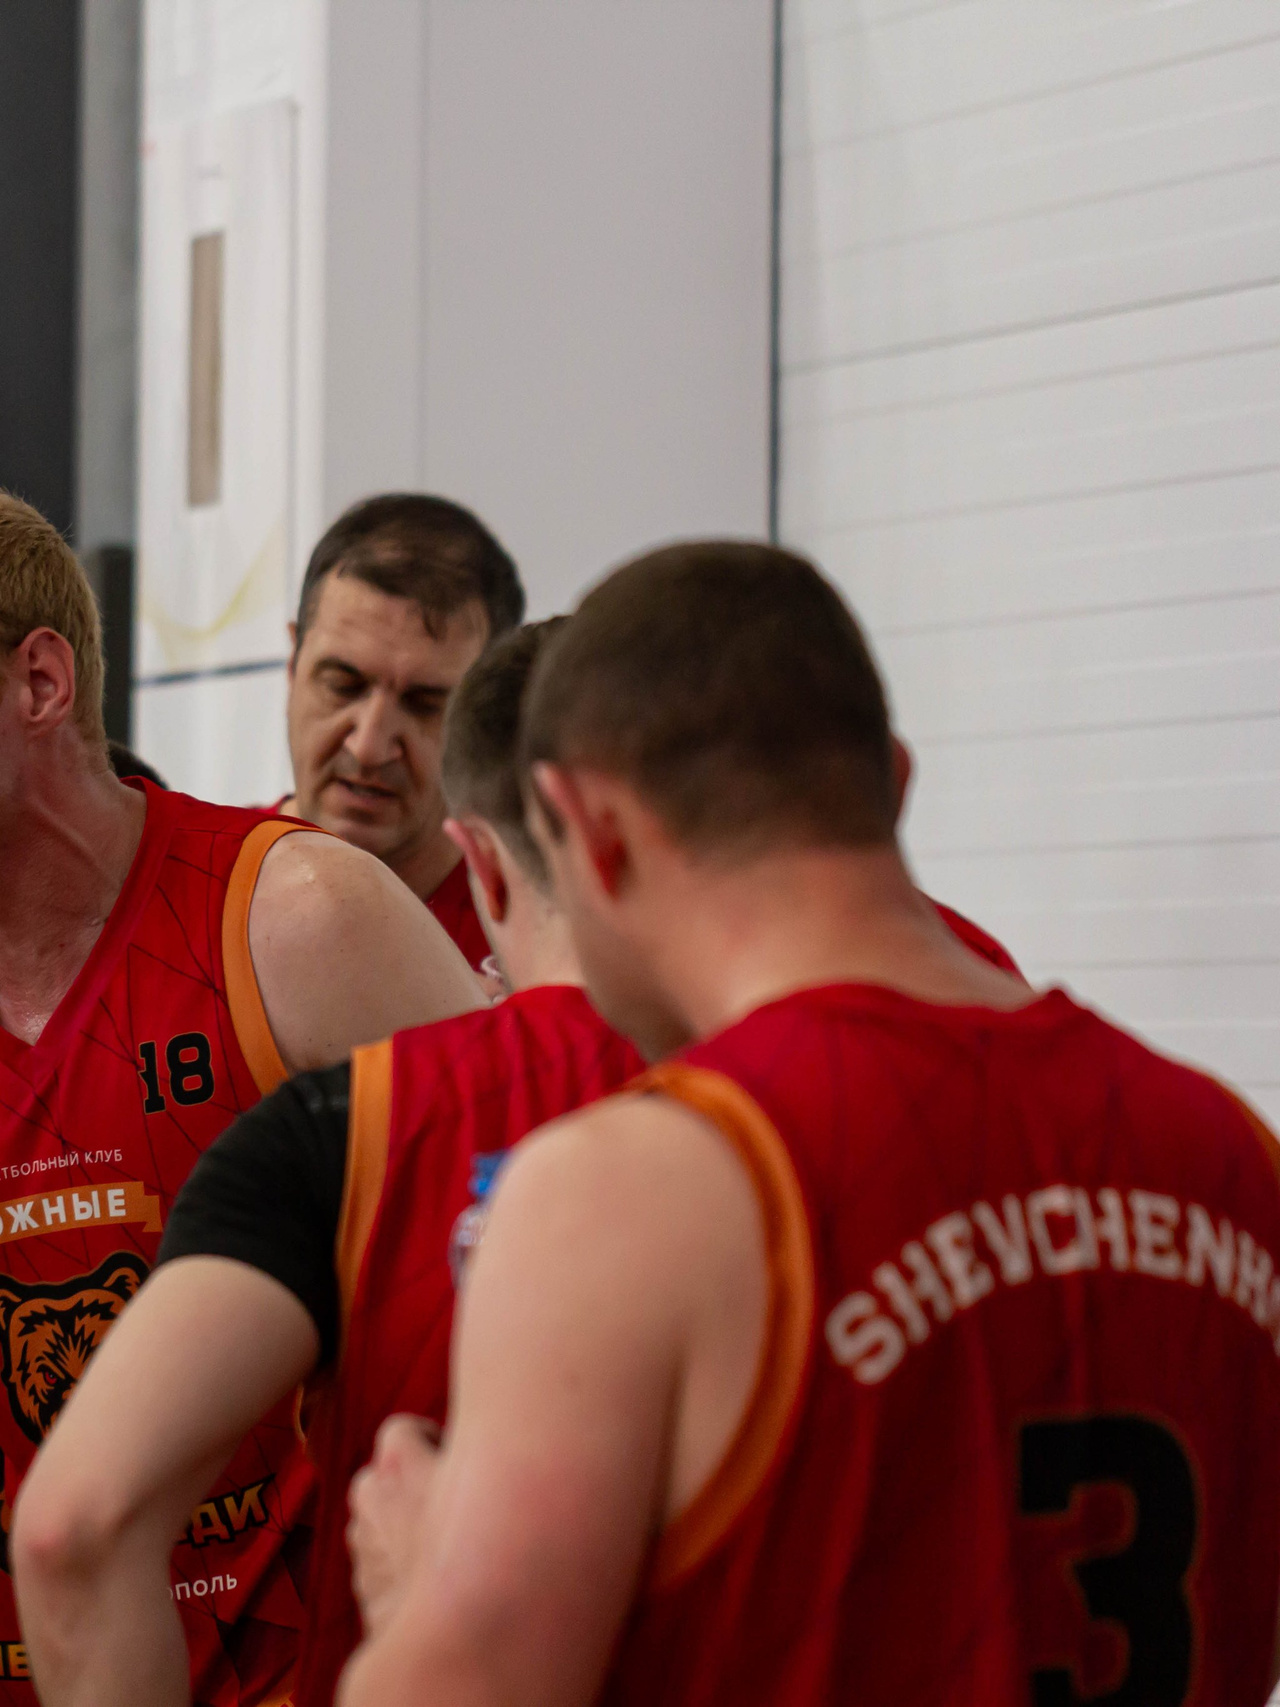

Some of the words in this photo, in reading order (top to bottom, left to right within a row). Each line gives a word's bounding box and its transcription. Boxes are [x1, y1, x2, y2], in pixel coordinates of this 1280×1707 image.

[138, 1031, 215, 1115] 18
[84, 1149, 123, 1164] КЛУБ
[1017, 1412, 1198, 1707] 3
